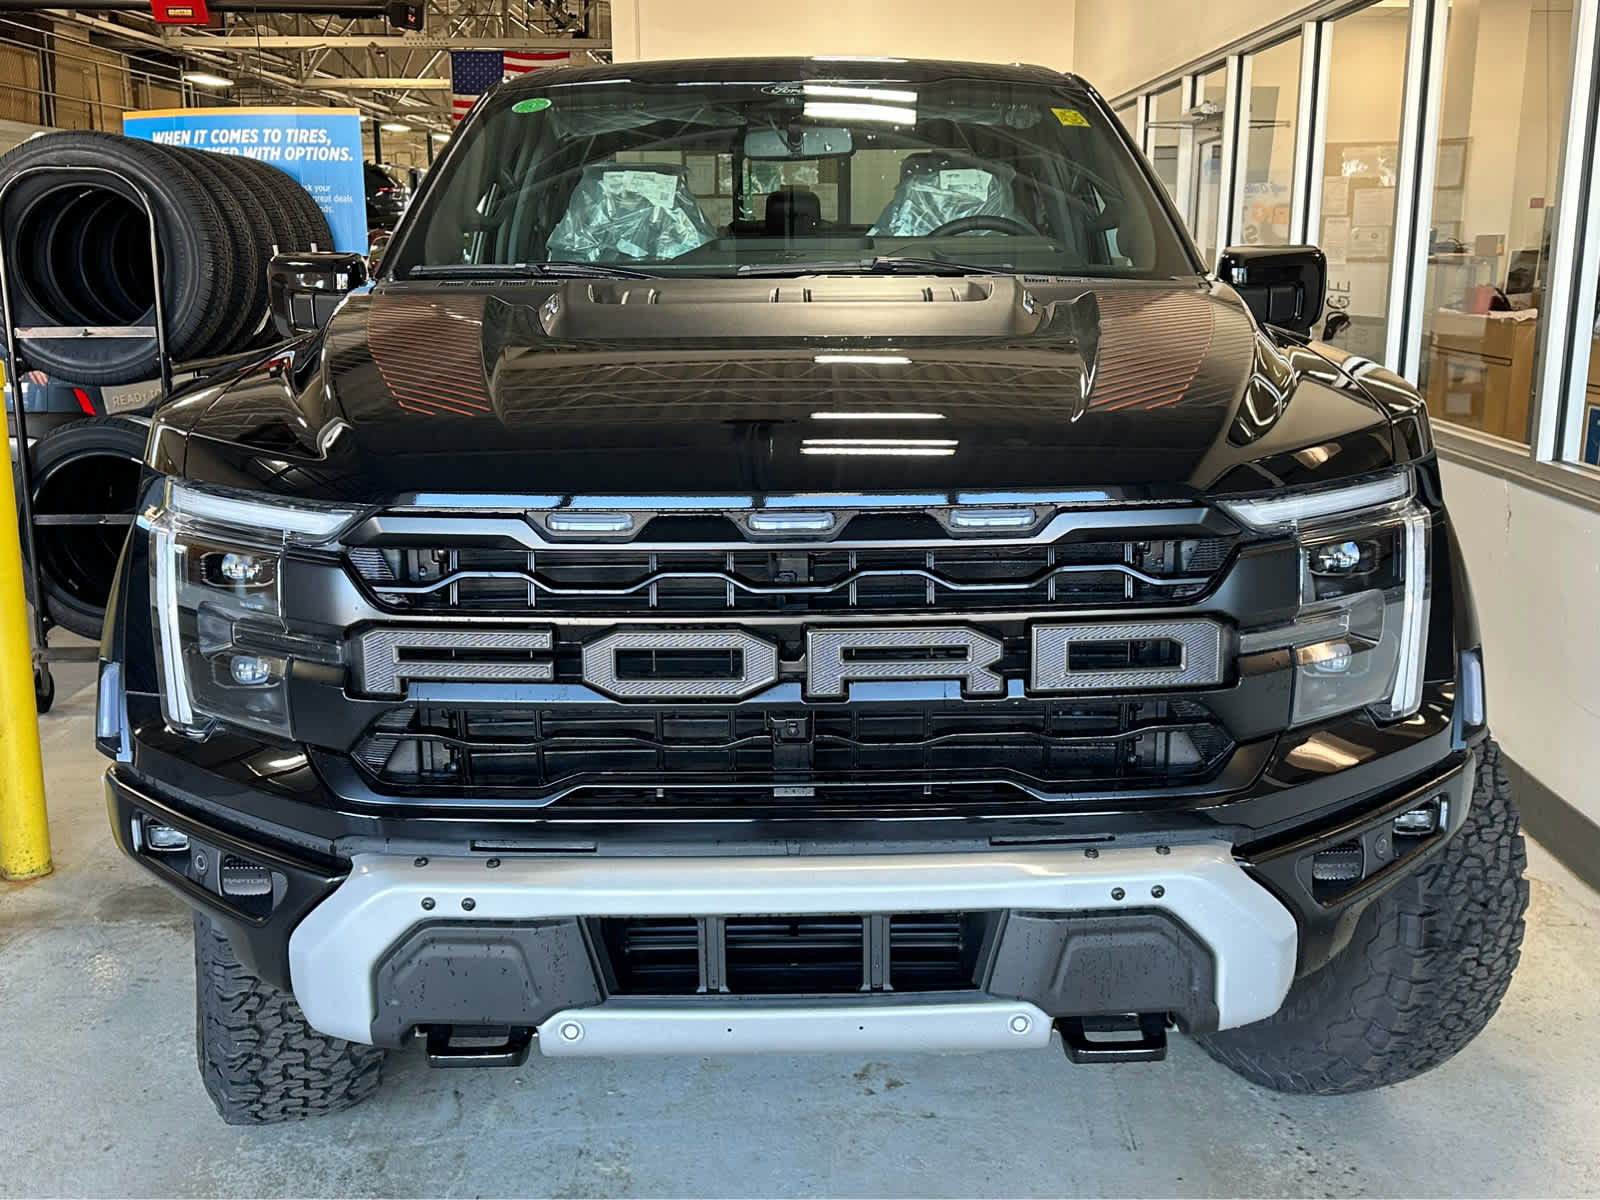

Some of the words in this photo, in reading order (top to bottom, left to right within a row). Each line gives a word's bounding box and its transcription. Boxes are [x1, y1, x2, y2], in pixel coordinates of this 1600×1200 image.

[152, 130, 191, 146] WHEN
[193, 129, 208, 144] IT
[210, 128, 259, 144] COMES
[263, 128, 282, 144] TO
[285, 128, 332, 146] TIRES,
[243, 146, 281, 161] WITH
[284, 146, 353, 161] OPTIONS.
[112, 391, 149, 405] READY
[360, 621, 1225, 702] FORD
